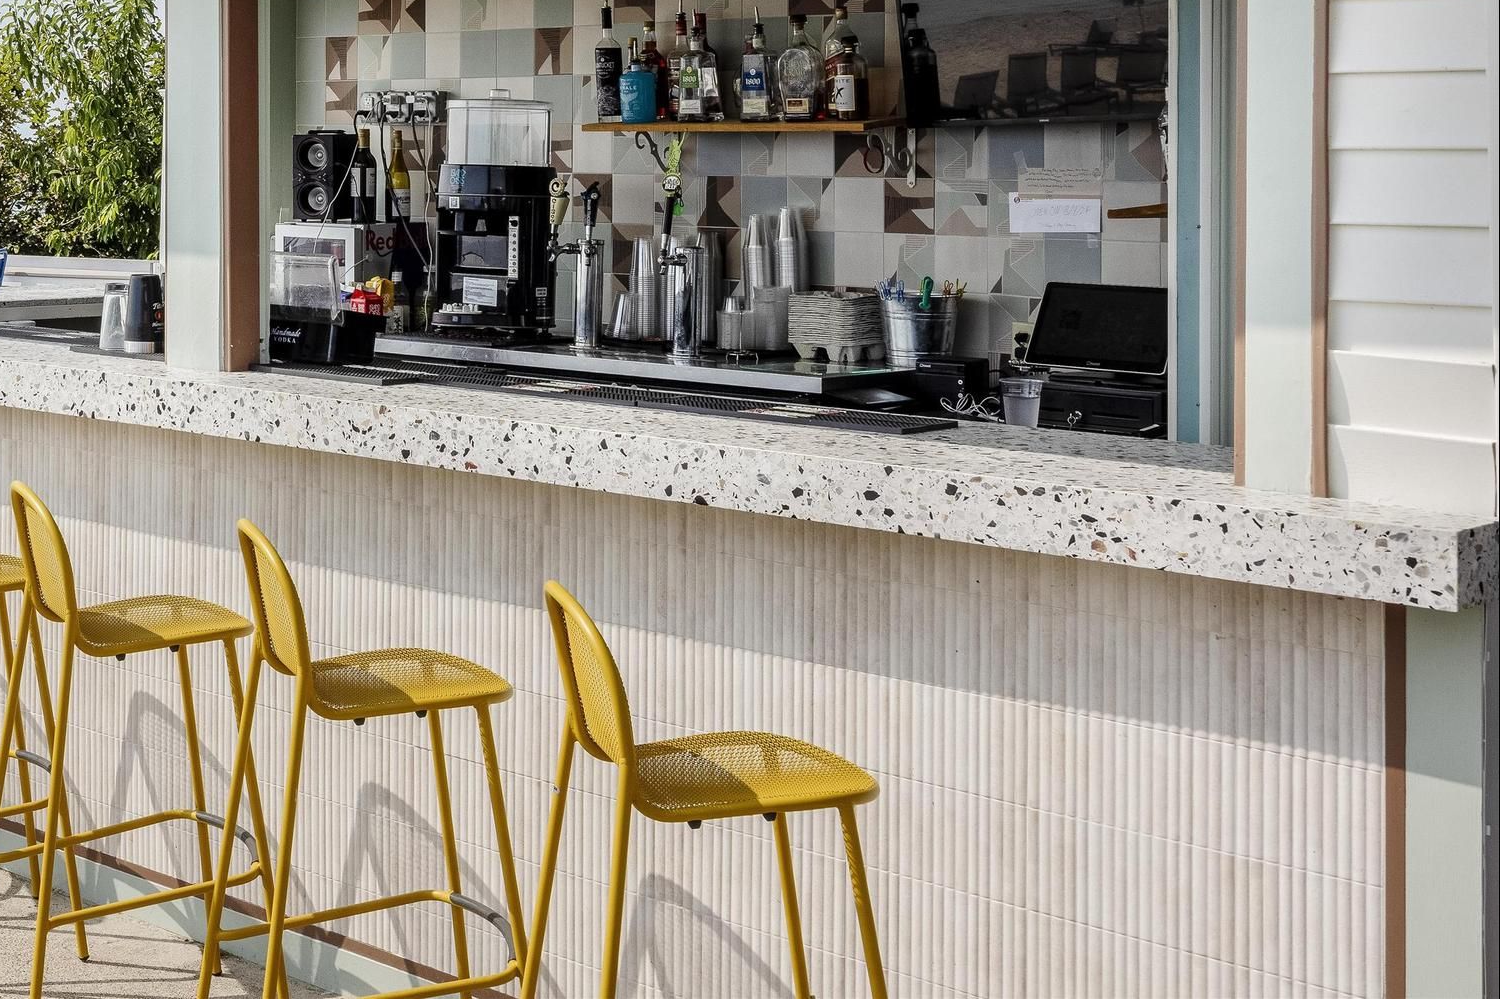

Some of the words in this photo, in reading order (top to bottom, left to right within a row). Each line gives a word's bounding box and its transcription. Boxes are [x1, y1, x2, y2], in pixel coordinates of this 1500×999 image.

[682, 75, 696, 83] 1800
[366, 228, 397, 251] Red
[273, 336, 297, 344] VODKA
